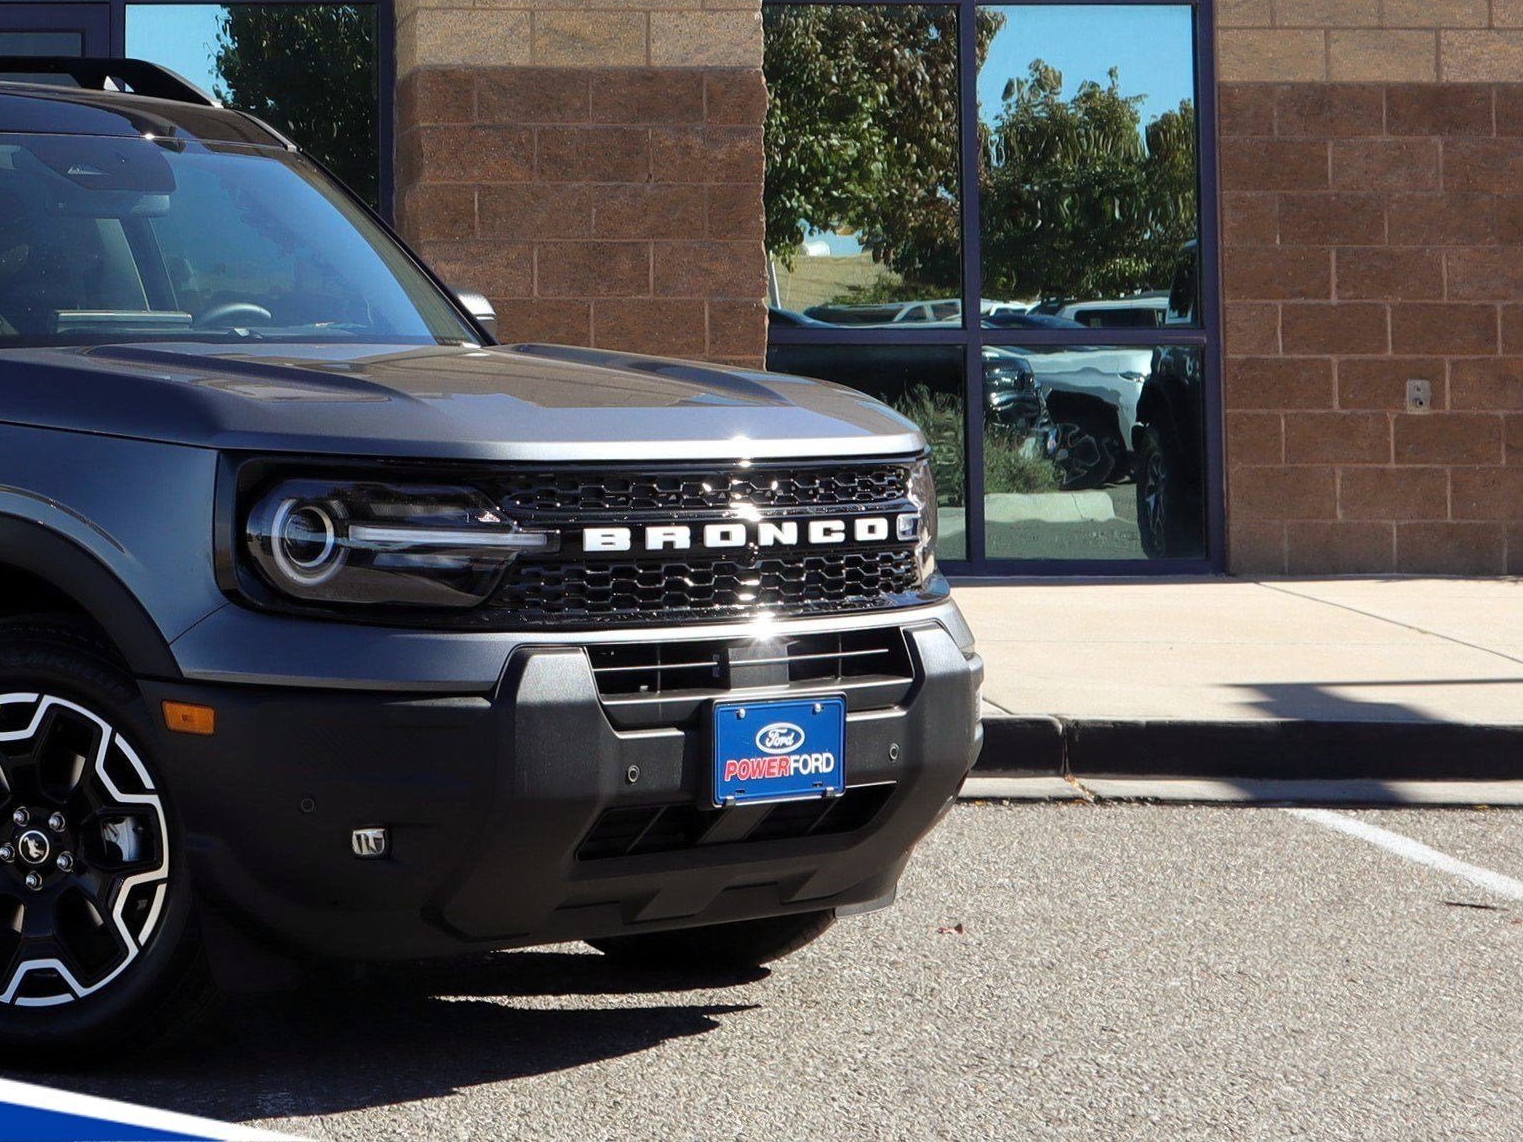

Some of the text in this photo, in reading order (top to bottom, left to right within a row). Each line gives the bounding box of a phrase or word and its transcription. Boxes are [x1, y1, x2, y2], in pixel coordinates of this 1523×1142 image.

[583, 518, 888, 551] BRONCO
[765, 728, 795, 748] Ford
[724, 752, 835, 781] POWERFORD
